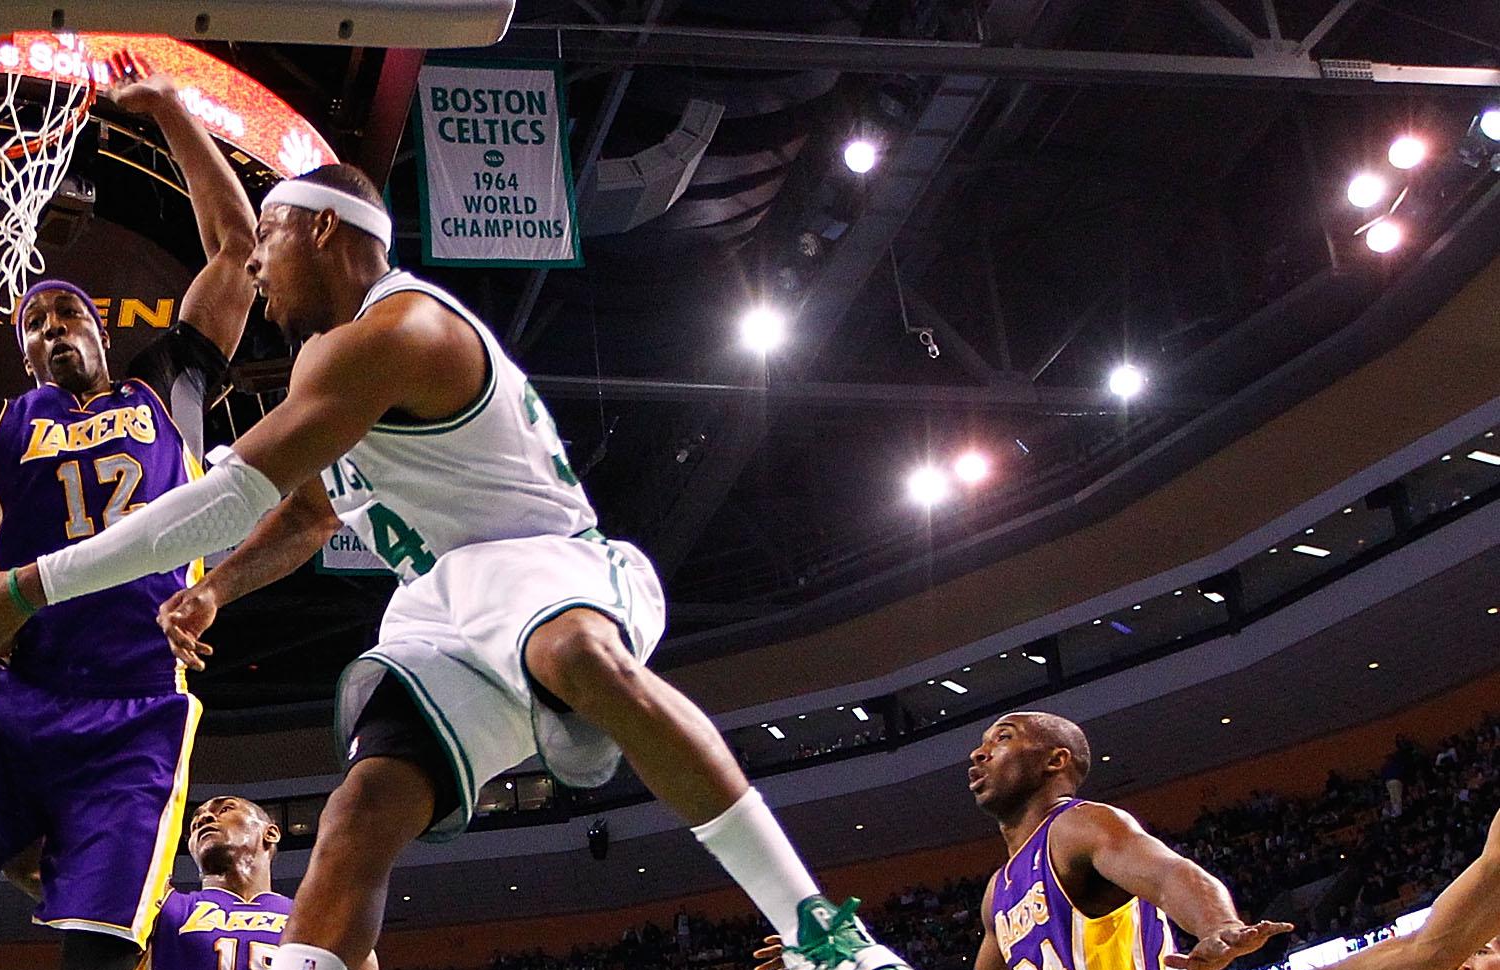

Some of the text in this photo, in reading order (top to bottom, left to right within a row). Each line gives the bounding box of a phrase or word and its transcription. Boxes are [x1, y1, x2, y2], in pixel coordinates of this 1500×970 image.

[430, 87, 547, 115] BOSTON
[438, 117, 545, 145] CELTICS
[473, 172, 518, 191] 1964
[463, 195, 537, 214] WORLD
[441, 217, 564, 239] CHAMPIONS
[20, 404, 156, 464] LAKERS
[56, 452, 149, 540] 12
[366, 502, 438, 575] 4
[179, 901, 291, 935] LAKER
